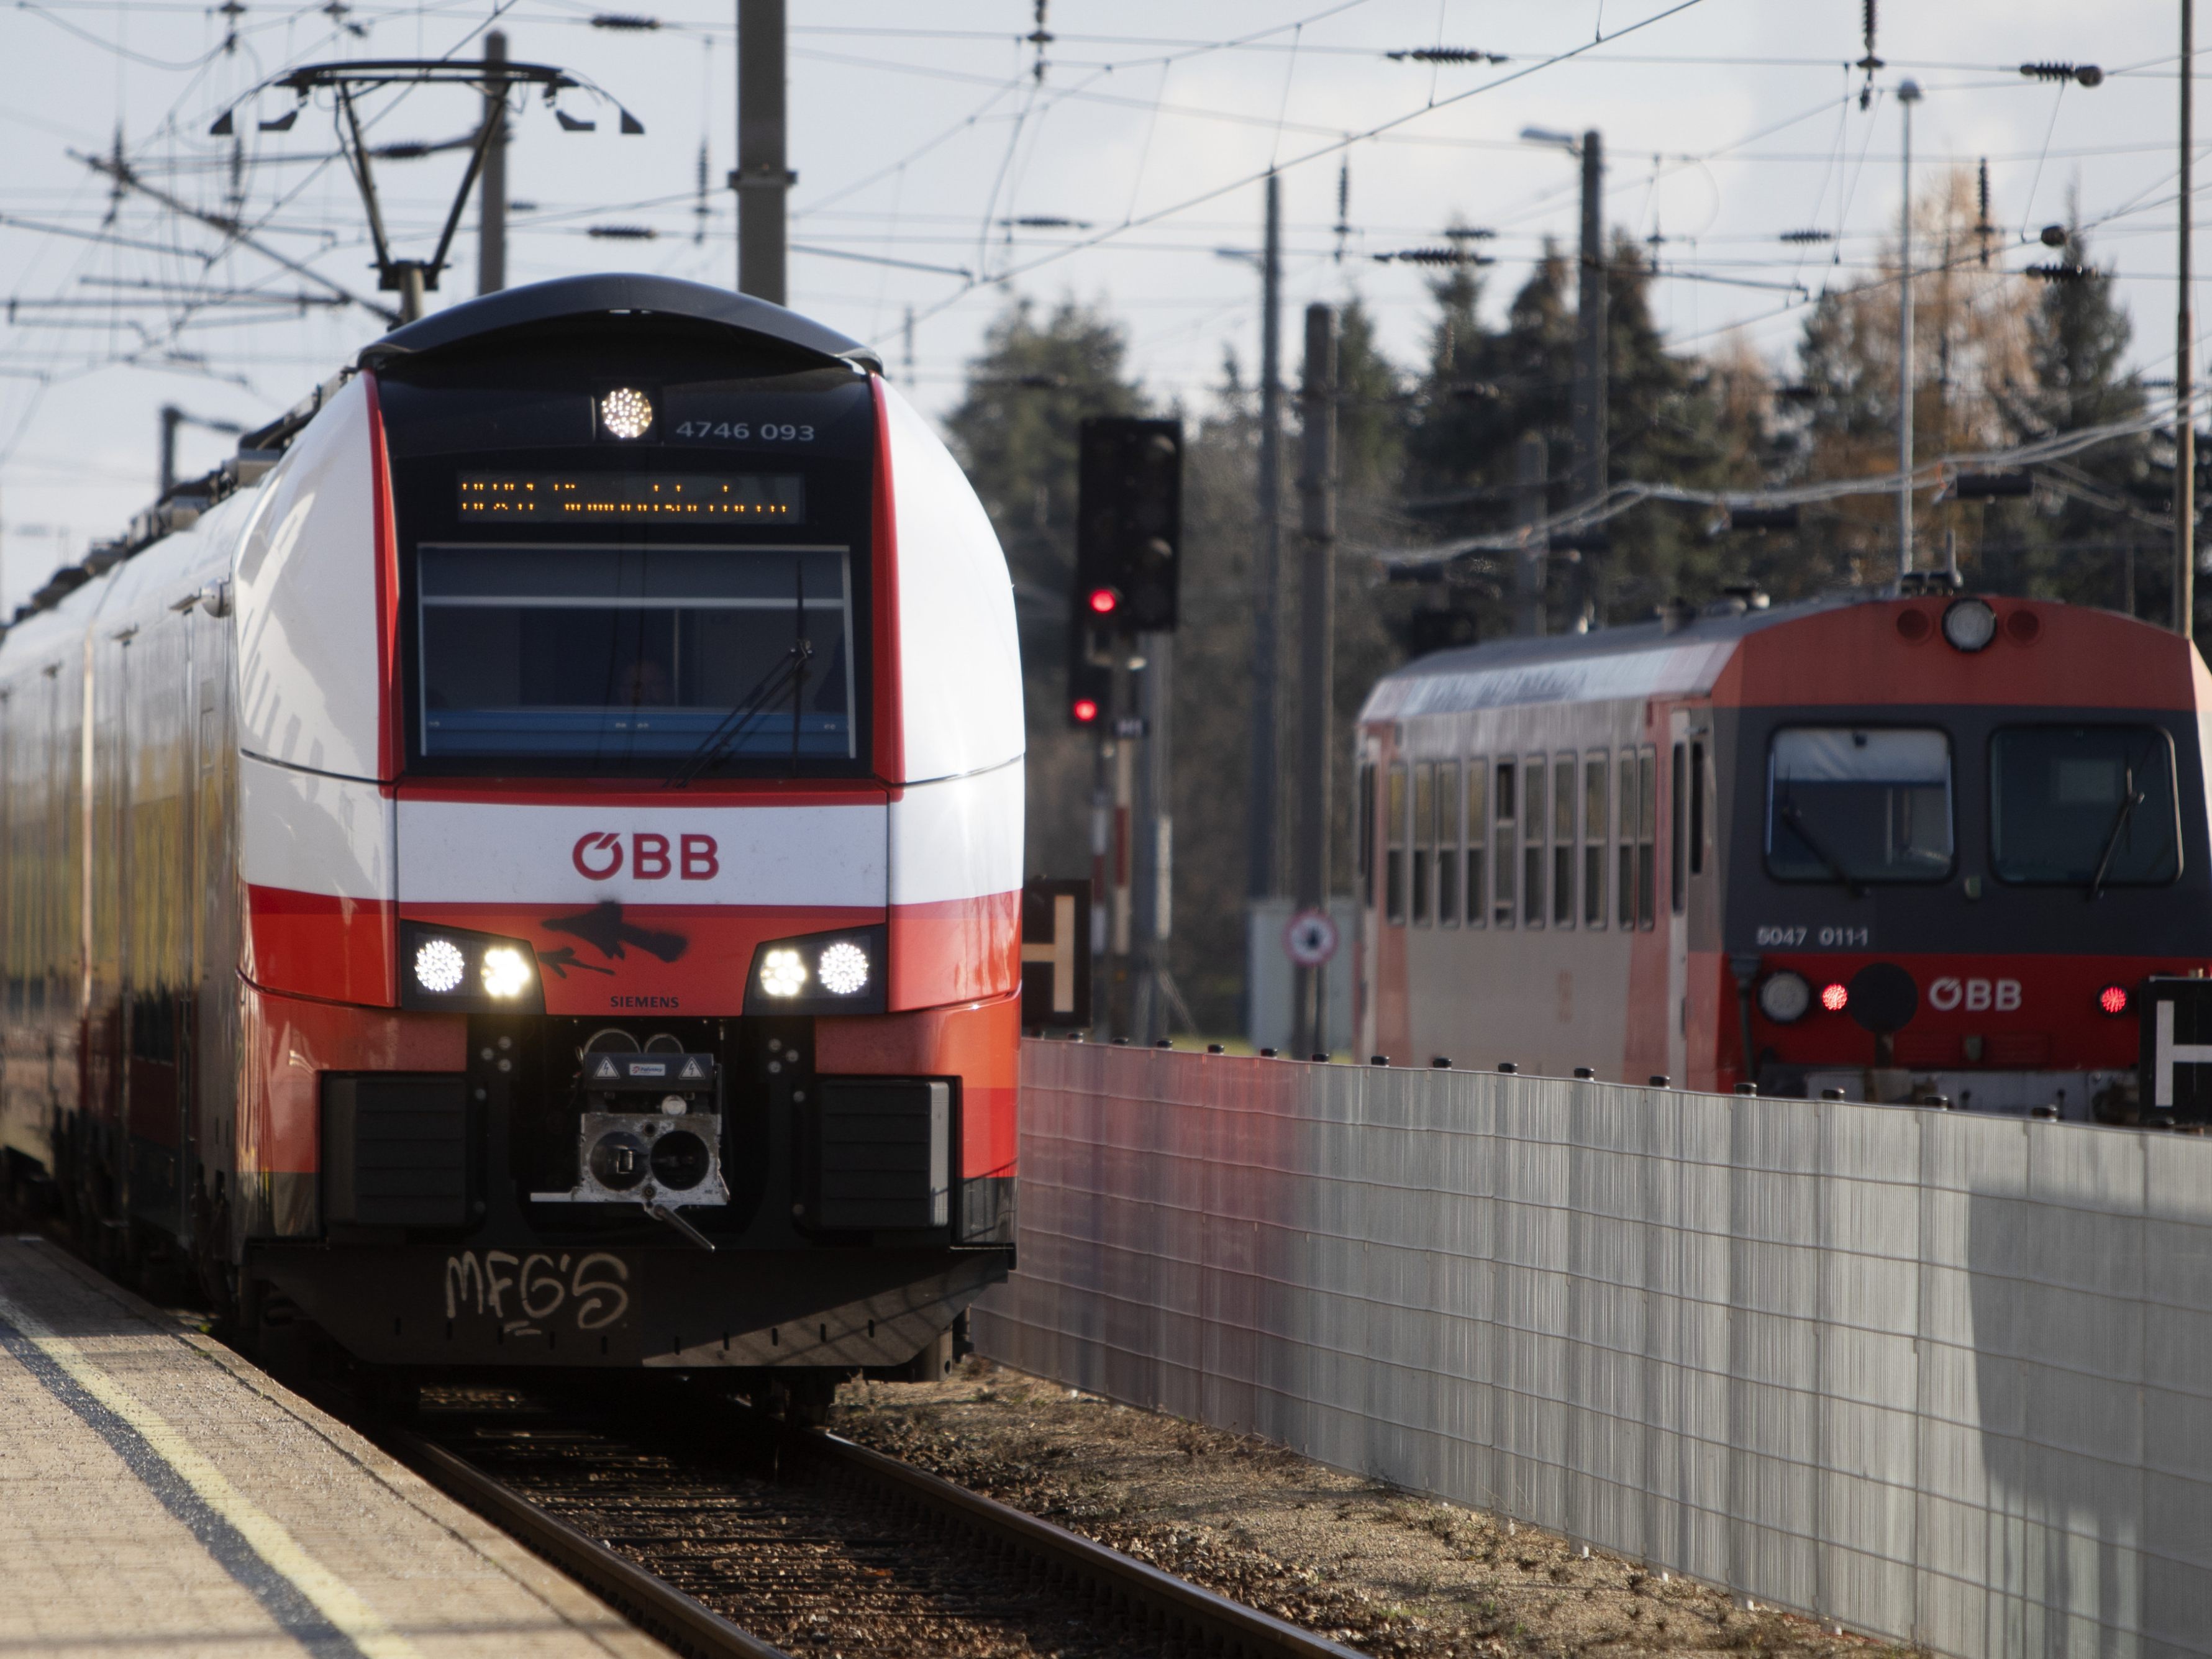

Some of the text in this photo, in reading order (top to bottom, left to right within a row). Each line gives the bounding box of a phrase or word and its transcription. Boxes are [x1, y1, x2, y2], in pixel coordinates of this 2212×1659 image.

[676, 421, 814, 442] 4746 093
[572, 831, 719, 881] ÖBB
[611, 996, 680, 1008] SIEMENS
[1928, 976, 2023, 1011] ÖBB
